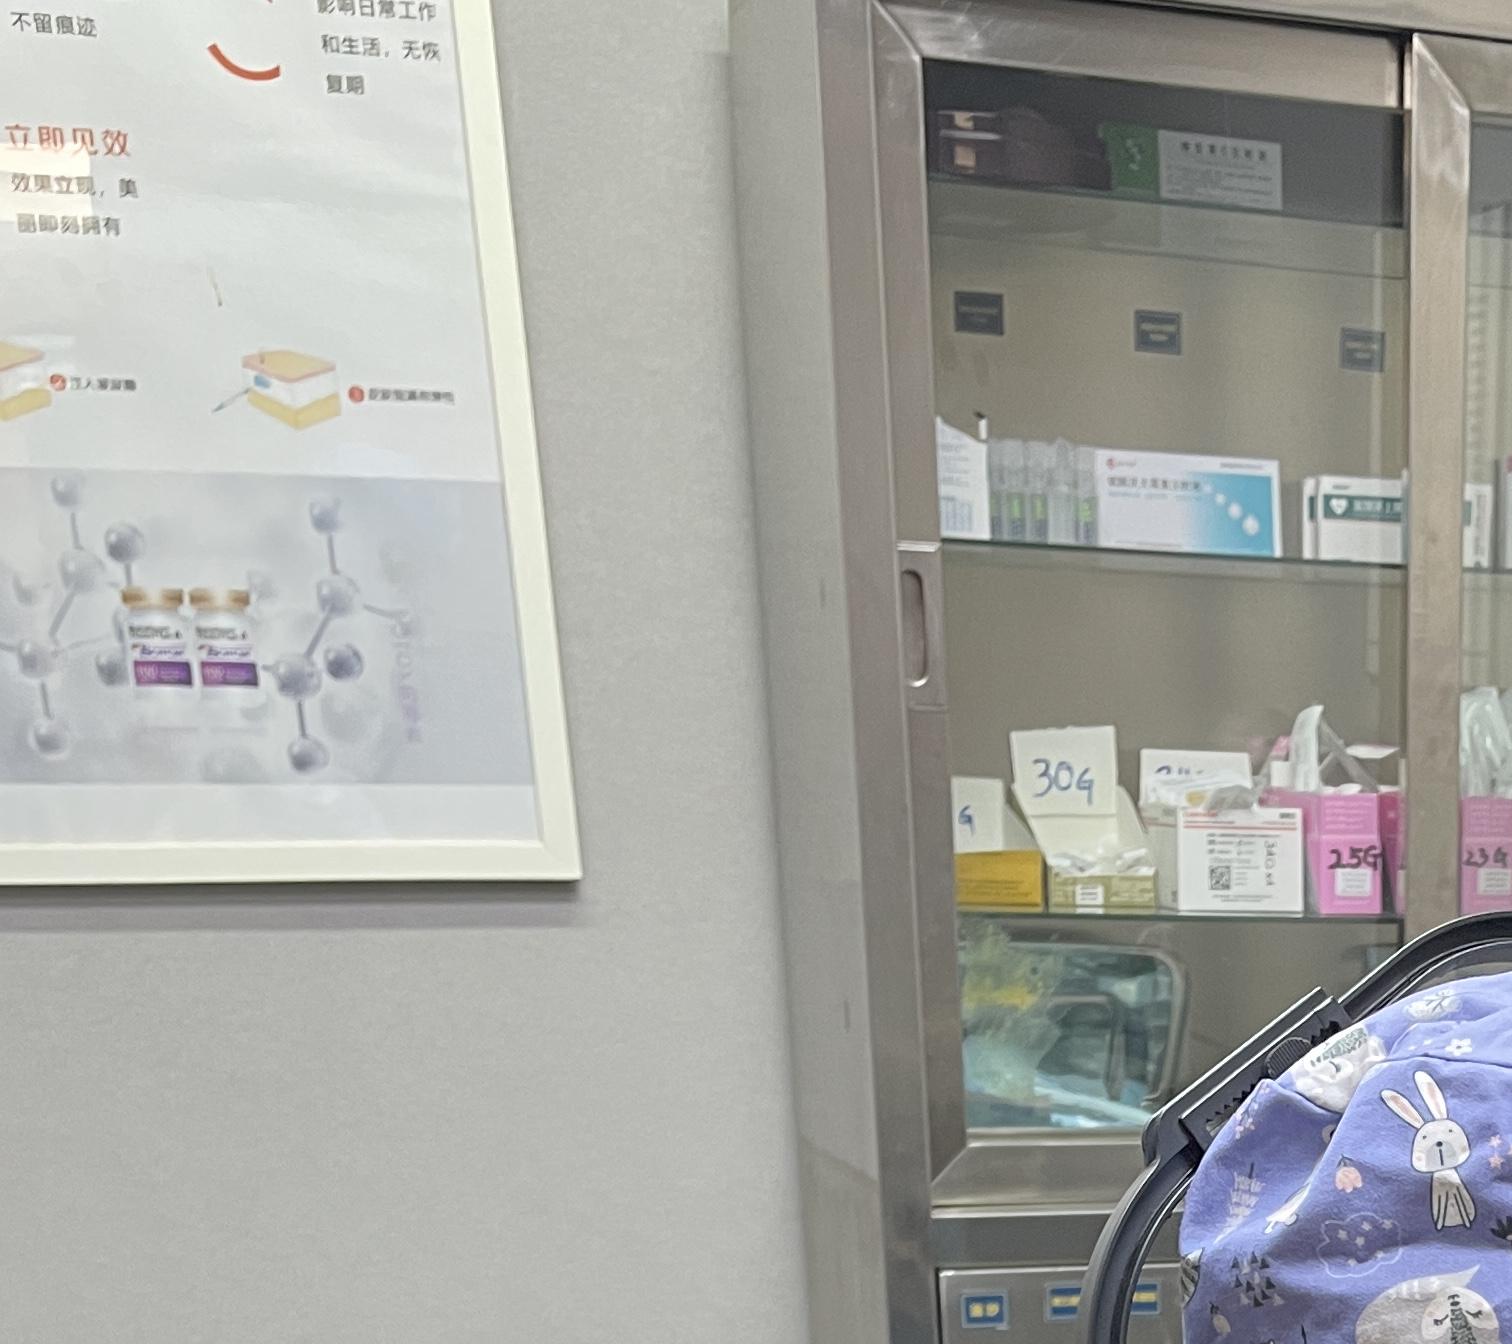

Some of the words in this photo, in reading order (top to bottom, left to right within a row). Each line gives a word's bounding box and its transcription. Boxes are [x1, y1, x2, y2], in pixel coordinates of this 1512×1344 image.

[10, 11, 98, 37] 不留痕迹
[4, 124, 131, 156] 立即见效
[1032, 758, 1094, 806] 30G
[1328, 844, 1385, 871] 25G
